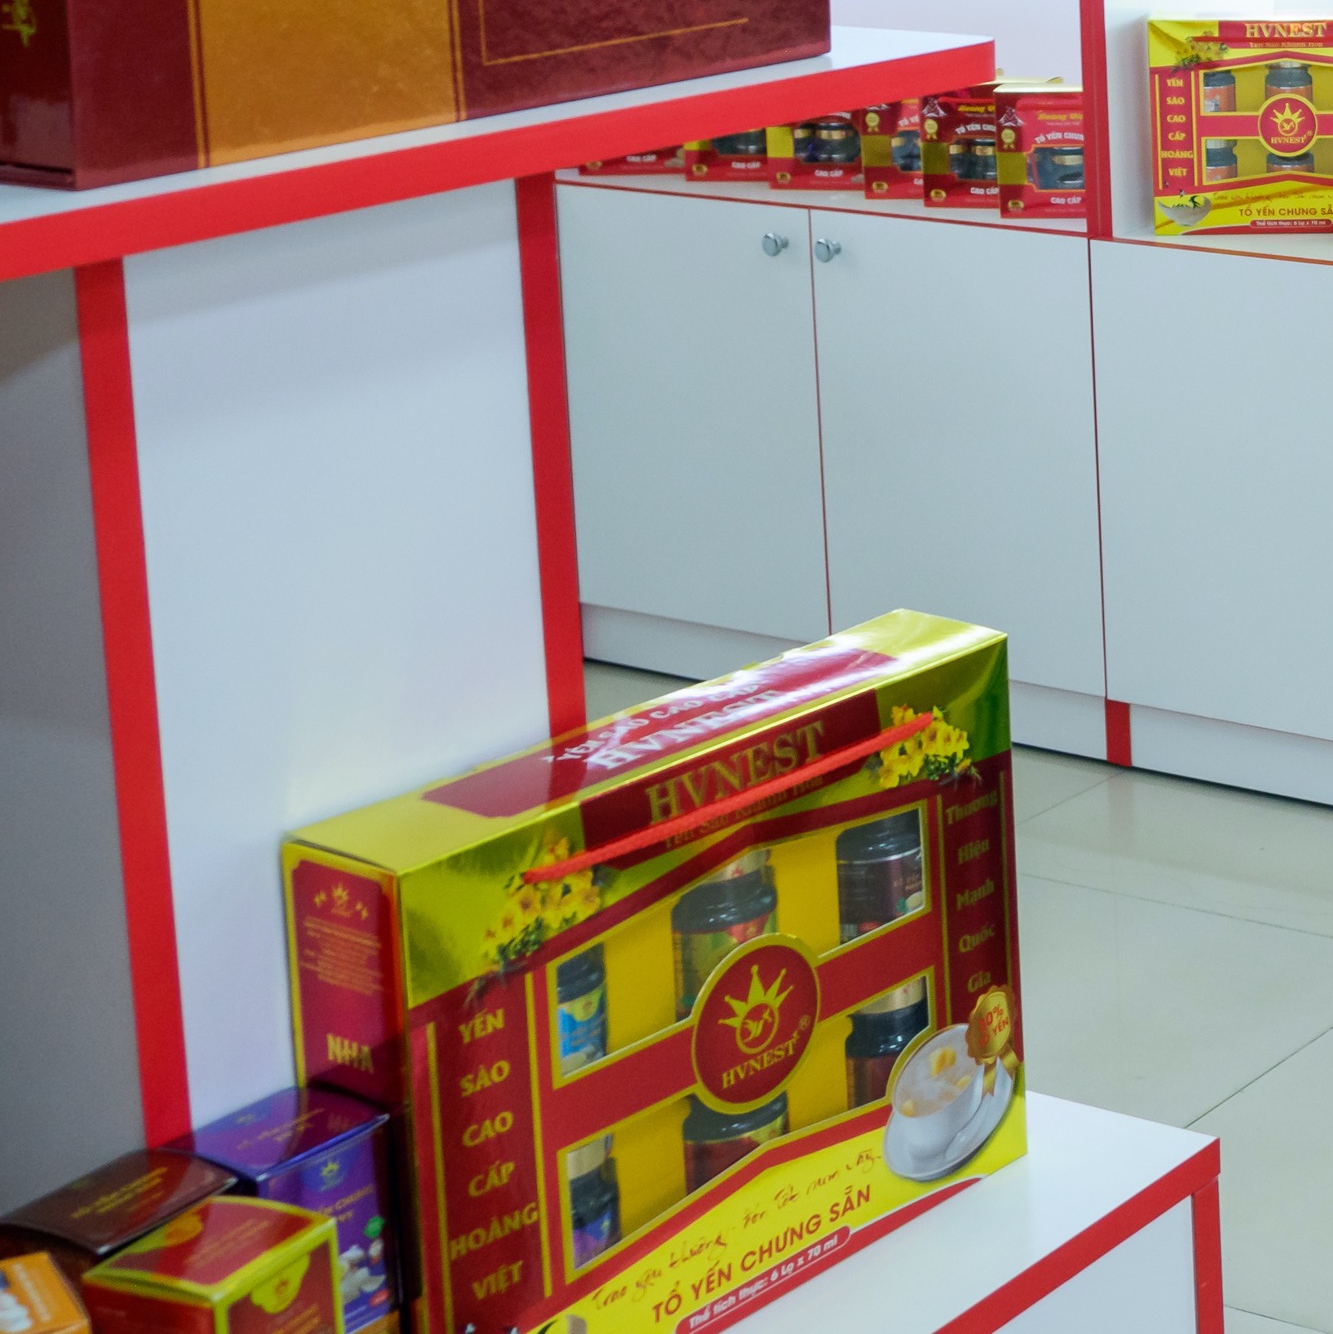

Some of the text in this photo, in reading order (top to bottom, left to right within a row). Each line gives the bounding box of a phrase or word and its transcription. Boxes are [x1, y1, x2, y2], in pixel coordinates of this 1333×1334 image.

[1245, 22, 1327, 38] HVNEST
[1278, 207, 1318, 217] CHƯNG
[644, 719, 827, 824] HVNEST
[458, 1007, 505, 1045] YẾN
[326, 1033, 374, 1074] NHA
[722, 1038, 794, 1090] HVNEST
[459, 1059, 511, 1098] SÀO
[462, 1111, 514, 1148] CAO
[467, 1159, 516, 1198] CẤP
[450, 1201, 540, 1262] HOÀNG
[691, 1258, 732, 1301] YẾN
[739, 1213, 821, 1274] CHƯNG
[828, 1184, 872, 1223] SẴN
[770, 1270, 778, 1282] 6
[798, 1260, 806, 1269] x
[807, 1246, 822, 1264] 70
[823, 1235, 839, 1253] ml
[471, 1259, 524, 1301] VIỆT
